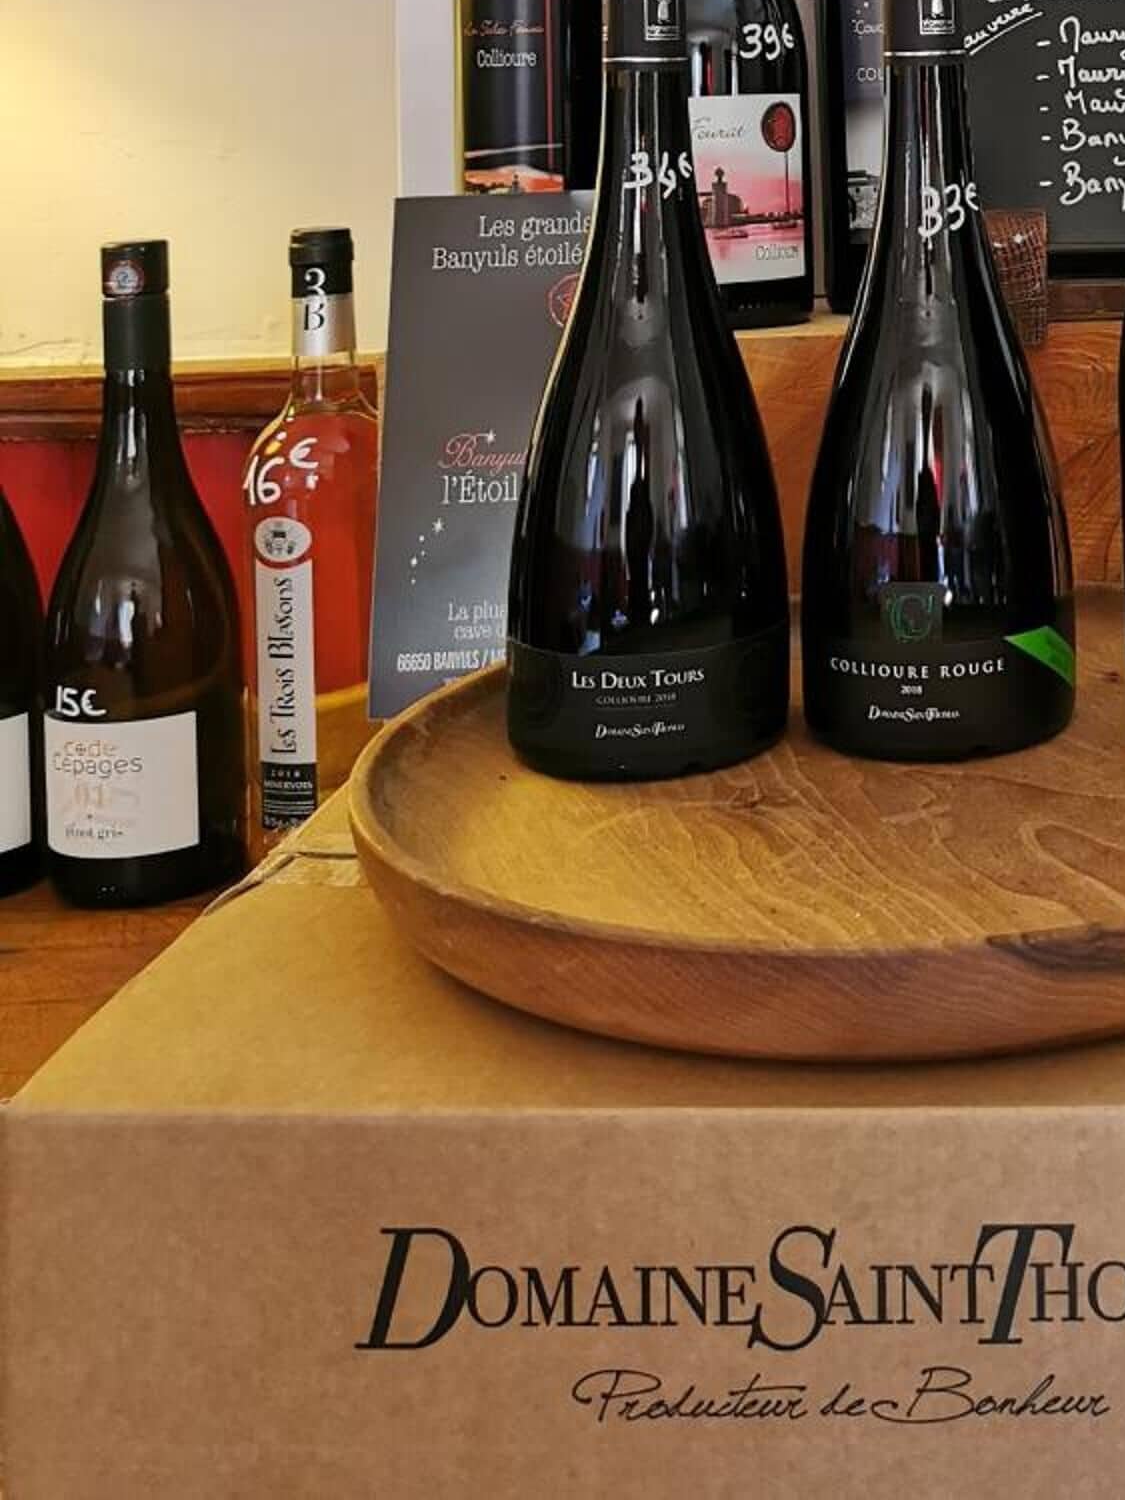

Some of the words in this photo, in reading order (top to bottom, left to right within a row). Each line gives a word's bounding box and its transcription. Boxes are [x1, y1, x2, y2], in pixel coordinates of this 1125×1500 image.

[477, 50, 537, 67] Collioure
[480, 215, 515, 237] Les
[521, 211, 591, 241] grands
[431, 244, 518, 273] Banyuls
[525, 242, 582, 266] étoilé
[438, 431, 527, 472] Banyul
[440, 470, 518, 504] l'Étoil
[448, 602, 468, 621] La
[397, 653, 431, 672] 66650
[830, 657, 930, 680] COLLIOURE
[940, 659, 1005, 677] ROUGE
[572, 1366, 810, 1426] Producteur
[820, 1380, 868, 1417] de
[872, 1364, 1111, 1426] Bonheur
